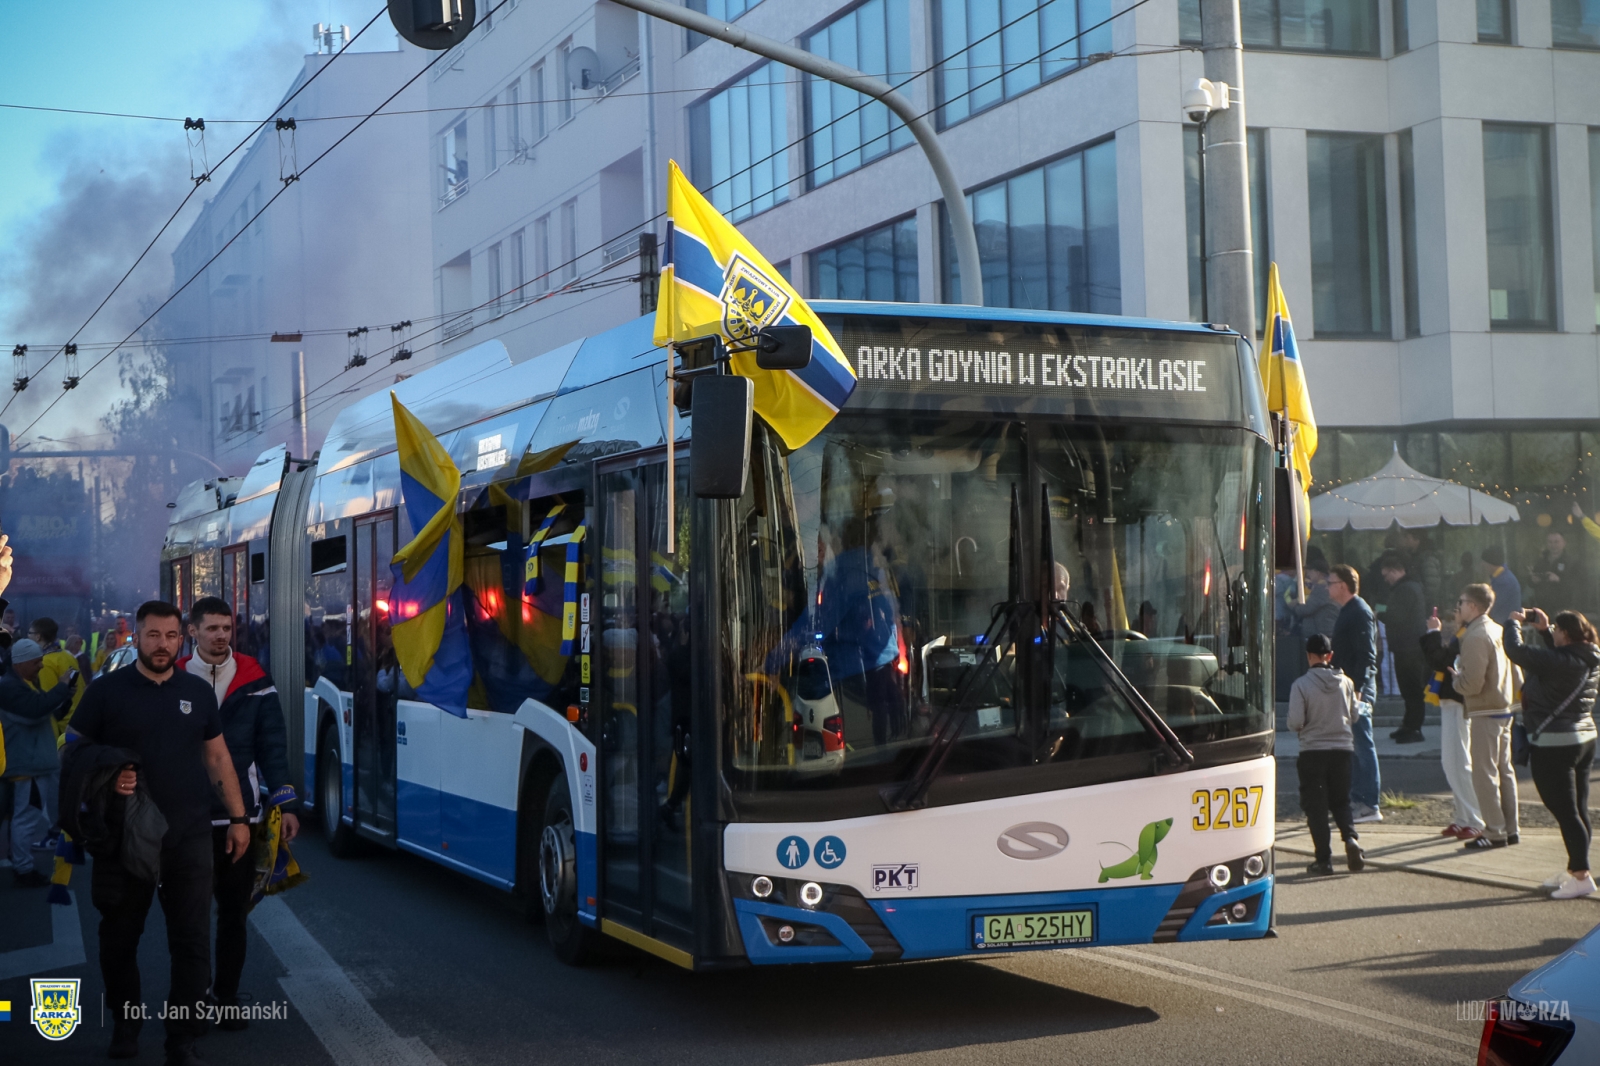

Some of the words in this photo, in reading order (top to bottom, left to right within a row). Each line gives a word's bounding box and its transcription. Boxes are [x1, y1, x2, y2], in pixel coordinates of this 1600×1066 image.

[858, 346, 921, 379] ARKA
[928, 350, 1011, 384] GDYNIA
[1019, 353, 1034, 385] W
[1041, 354, 1206, 392] EKSTRAKLASIE
[1192, 785, 1263, 831] 3267
[875, 864, 916, 886] PKT
[989, 917, 1015, 940] GA
[1024, 914, 1087, 939] 525HY
